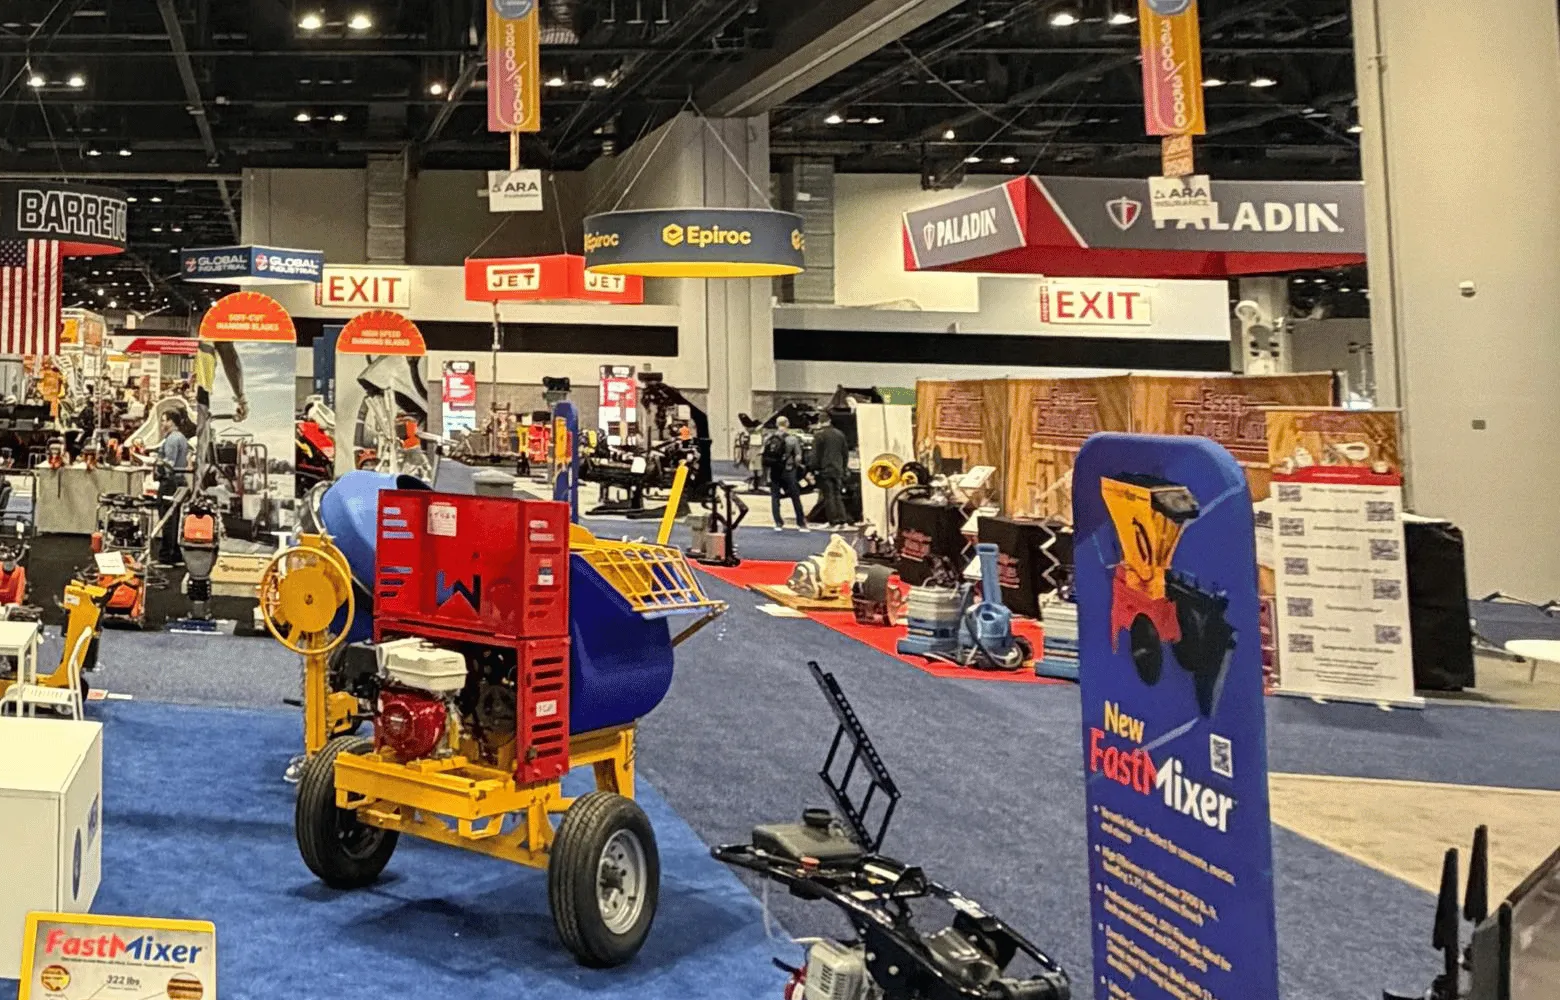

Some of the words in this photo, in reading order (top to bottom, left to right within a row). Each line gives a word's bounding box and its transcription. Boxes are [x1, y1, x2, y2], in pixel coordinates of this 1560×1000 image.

[504, 181, 539, 192] ARA
[1169, 187, 1207, 199] ARA
[687, 225, 751, 248] Epiroc
[936, 208, 997, 248] PALADIN
[198, 255, 248, 267] GLOBAL
[269, 256, 319, 268] GLOBAL
[329, 276, 402, 303] EXIT
[493, 274, 535, 288] JET
[589, 276, 622, 289] JET
[1056, 291, 1141, 320] EXIT
[1104, 700, 1145, 744] New
[1090, 727, 1234, 833] FastMixer
[44, 927, 203, 964] FastMixer
[106, 974, 125, 985] 322
